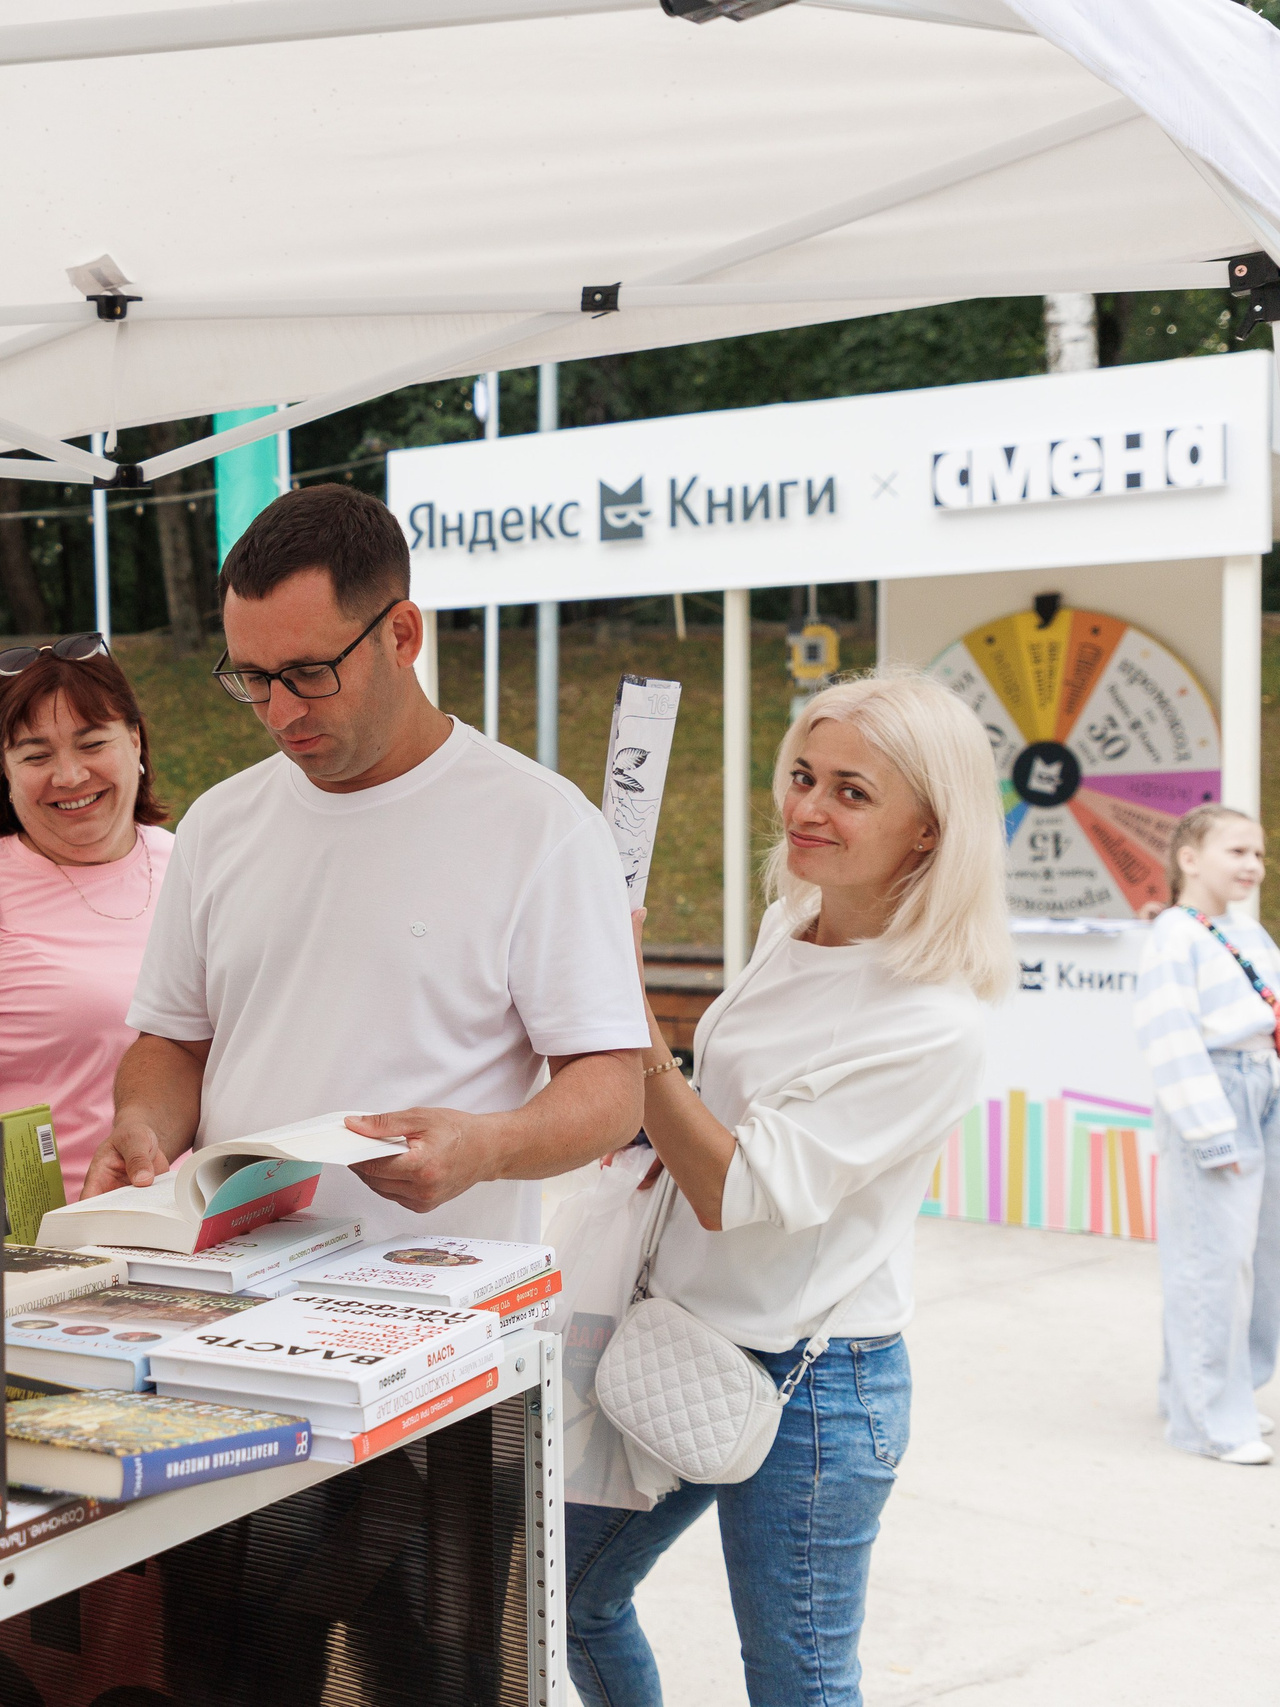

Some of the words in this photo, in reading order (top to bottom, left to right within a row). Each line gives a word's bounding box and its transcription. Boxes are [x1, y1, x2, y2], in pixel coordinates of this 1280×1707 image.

[410, 494, 581, 556] Яндекс
[668, 473, 838, 529] Книги
[1087, 714, 1131, 761] 30
[1029, 830, 1071, 862] 45
[67, 1279, 107, 1300] РОЖДЕНИЕ
[292, 1296, 478, 1321] ПФЕФФЕР
[313, 1305, 467, 1325] ДЖЕФФРИ
[499, 1312, 528, 1329] РОЖДАЕТС
[195, 1334, 388, 1366] ВЛАСТЬ
[313, 1341, 402, 1355] Почему
[379, 1368, 406, 1390] ПФЕФФЕР
[426, 1344, 455, 1367] ВЛАСТЬ
[414, 1372, 450, 1400] КАЖДОГО
[375, 1398, 392, 1420] ДАР
[394, 1389, 414, 1411] СВОЙ
[165, 1455, 210, 1479] ИМПЕРИЯ
[212, 1440, 280, 1469] ВИЗАНТИЙСКАЯ
[28, 1506, 85, 1539] Сознание.
